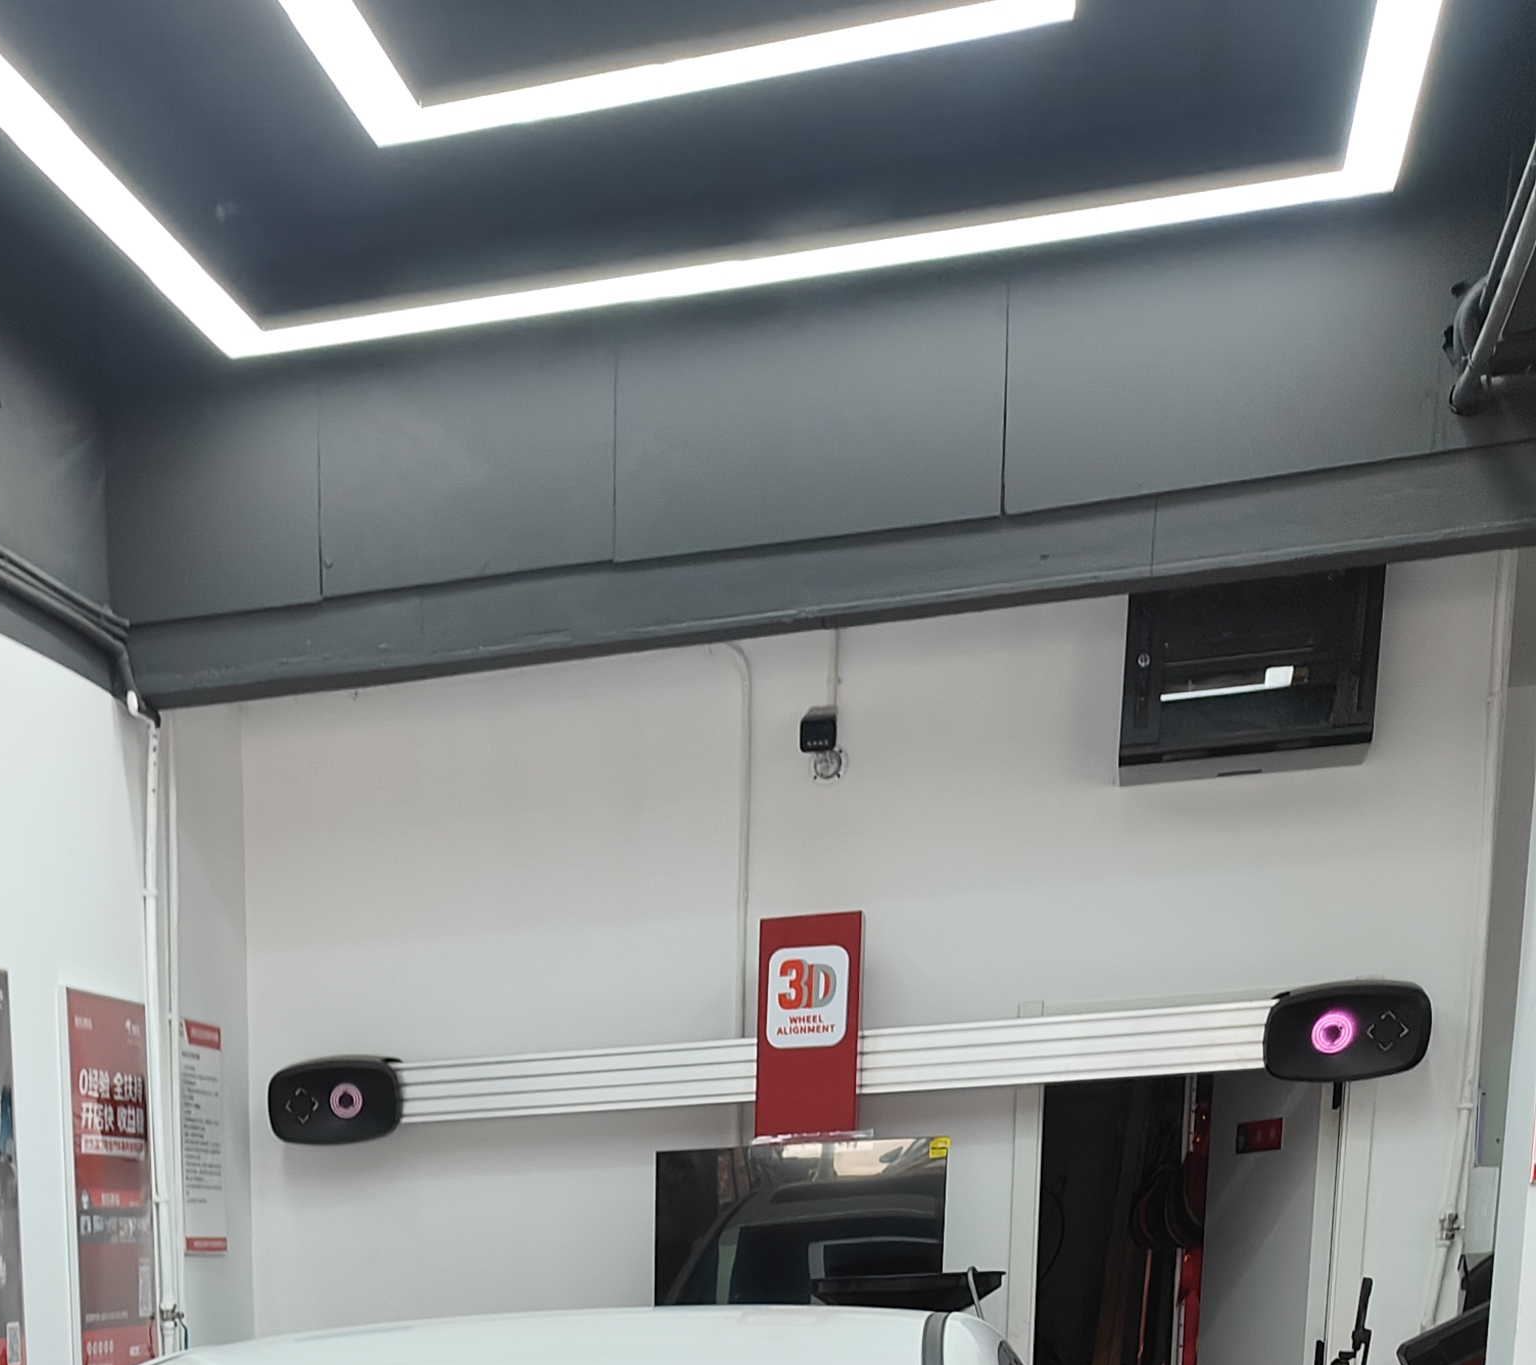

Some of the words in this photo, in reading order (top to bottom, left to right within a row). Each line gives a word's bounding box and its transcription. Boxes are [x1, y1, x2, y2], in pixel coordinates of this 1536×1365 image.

[777, 957, 837, 1010] 3D
[776, 1023, 835, 1036] ALIGNMENT
[789, 1013, 823, 1025] WHEEL
[78, 1067, 110, 1099] 0经验
